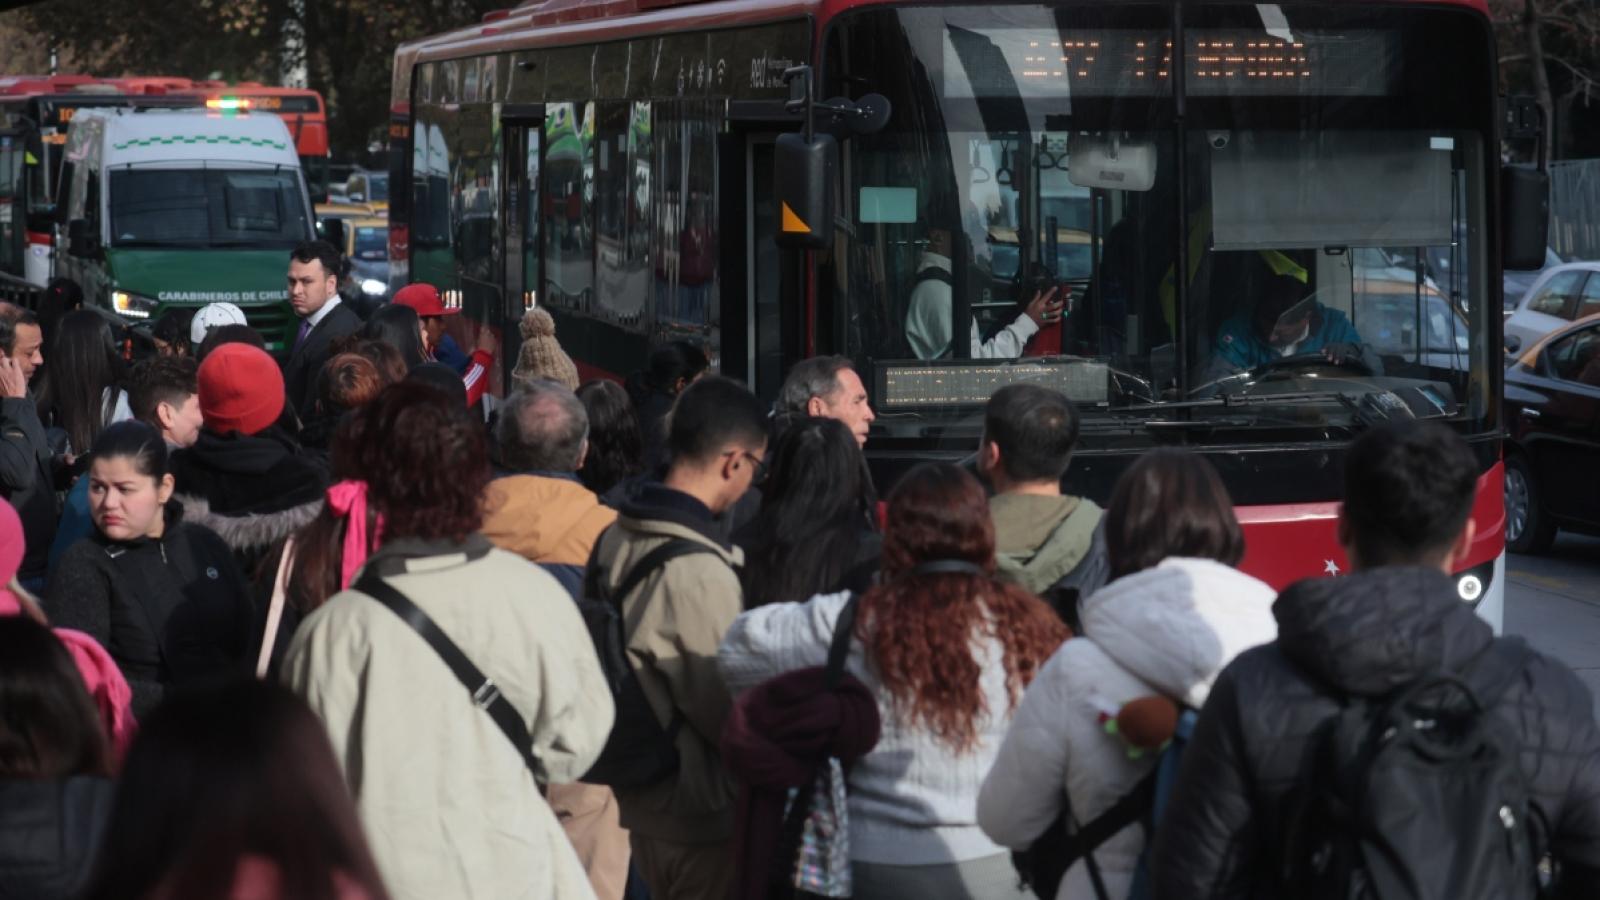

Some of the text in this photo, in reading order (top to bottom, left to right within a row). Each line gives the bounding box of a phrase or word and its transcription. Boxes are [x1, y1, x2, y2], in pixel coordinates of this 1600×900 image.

[157, 290, 290, 301] CARABINEROS DE CHILE
